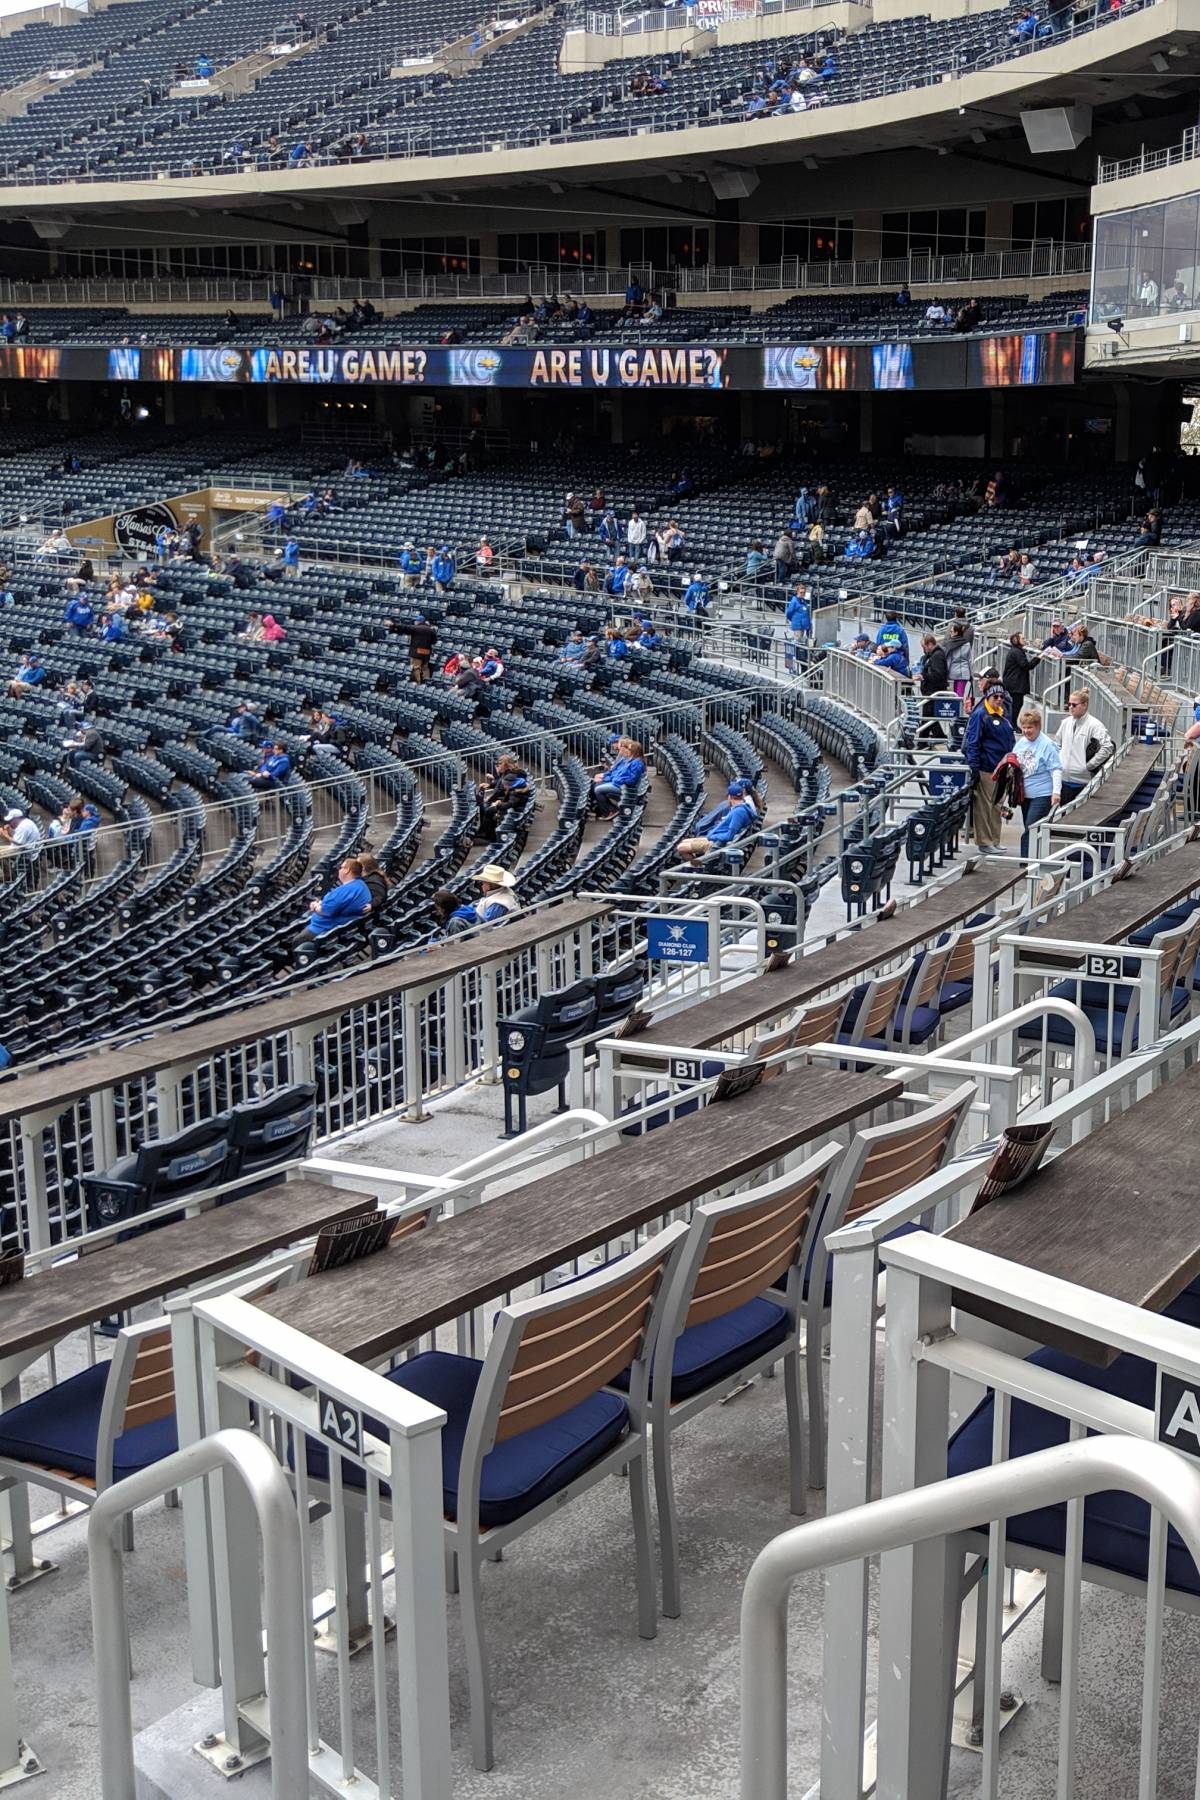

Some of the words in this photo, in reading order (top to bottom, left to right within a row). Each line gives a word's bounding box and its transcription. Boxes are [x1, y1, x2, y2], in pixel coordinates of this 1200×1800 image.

[266, 350, 310, 380] ARE
[318, 350, 334, 381] U
[342, 350, 427, 382] GAME?
[531, 351, 582, 383] ARE
[591, 350, 610, 383] U
[619, 350, 718, 385] GAME?
[1089, 832, 1102, 842] C1
[1091, 957, 1118, 976] B2
[675, 1061, 696, 1078] B1
[322, 1400, 357, 1449] A2
